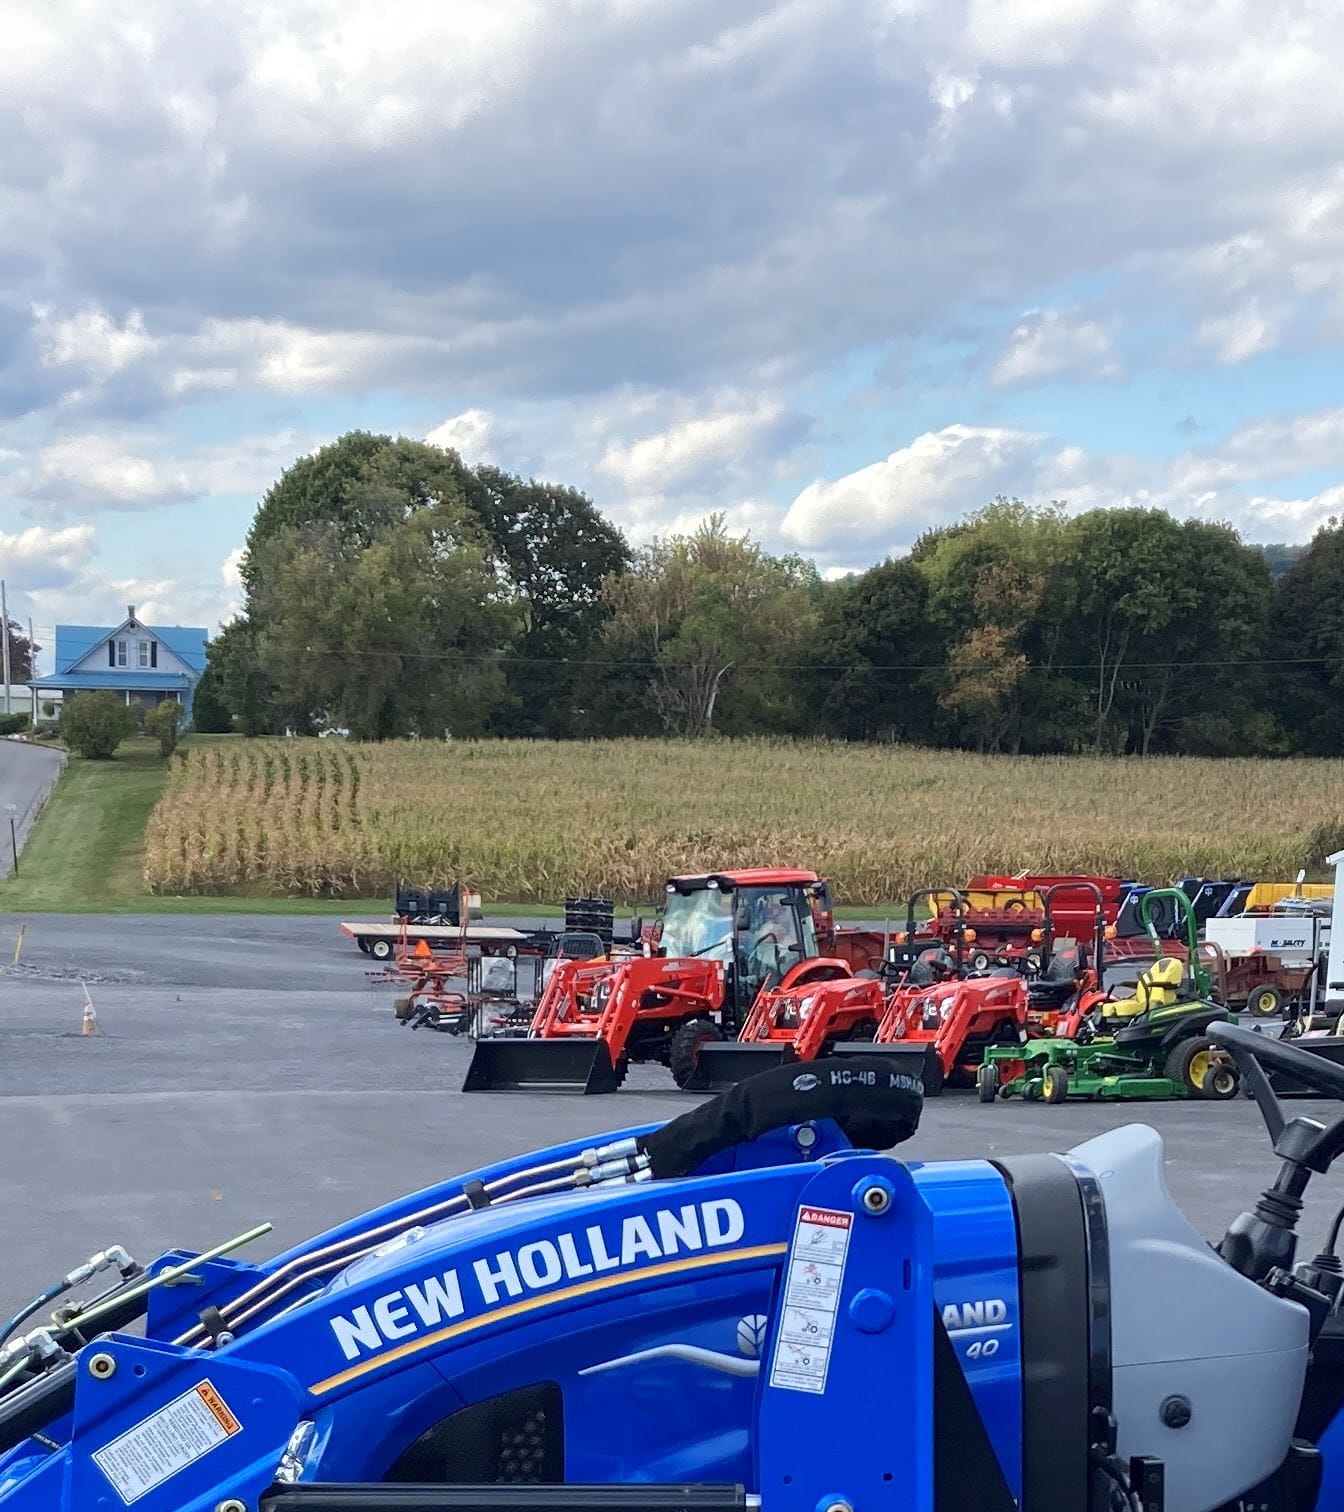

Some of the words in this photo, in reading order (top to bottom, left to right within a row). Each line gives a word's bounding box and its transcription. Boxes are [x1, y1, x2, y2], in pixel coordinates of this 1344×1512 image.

[809, 1213, 849, 1226] DANGER
[329, 1268, 466, 1361] NEW
[472, 1198, 745, 1304] HOLLAND
